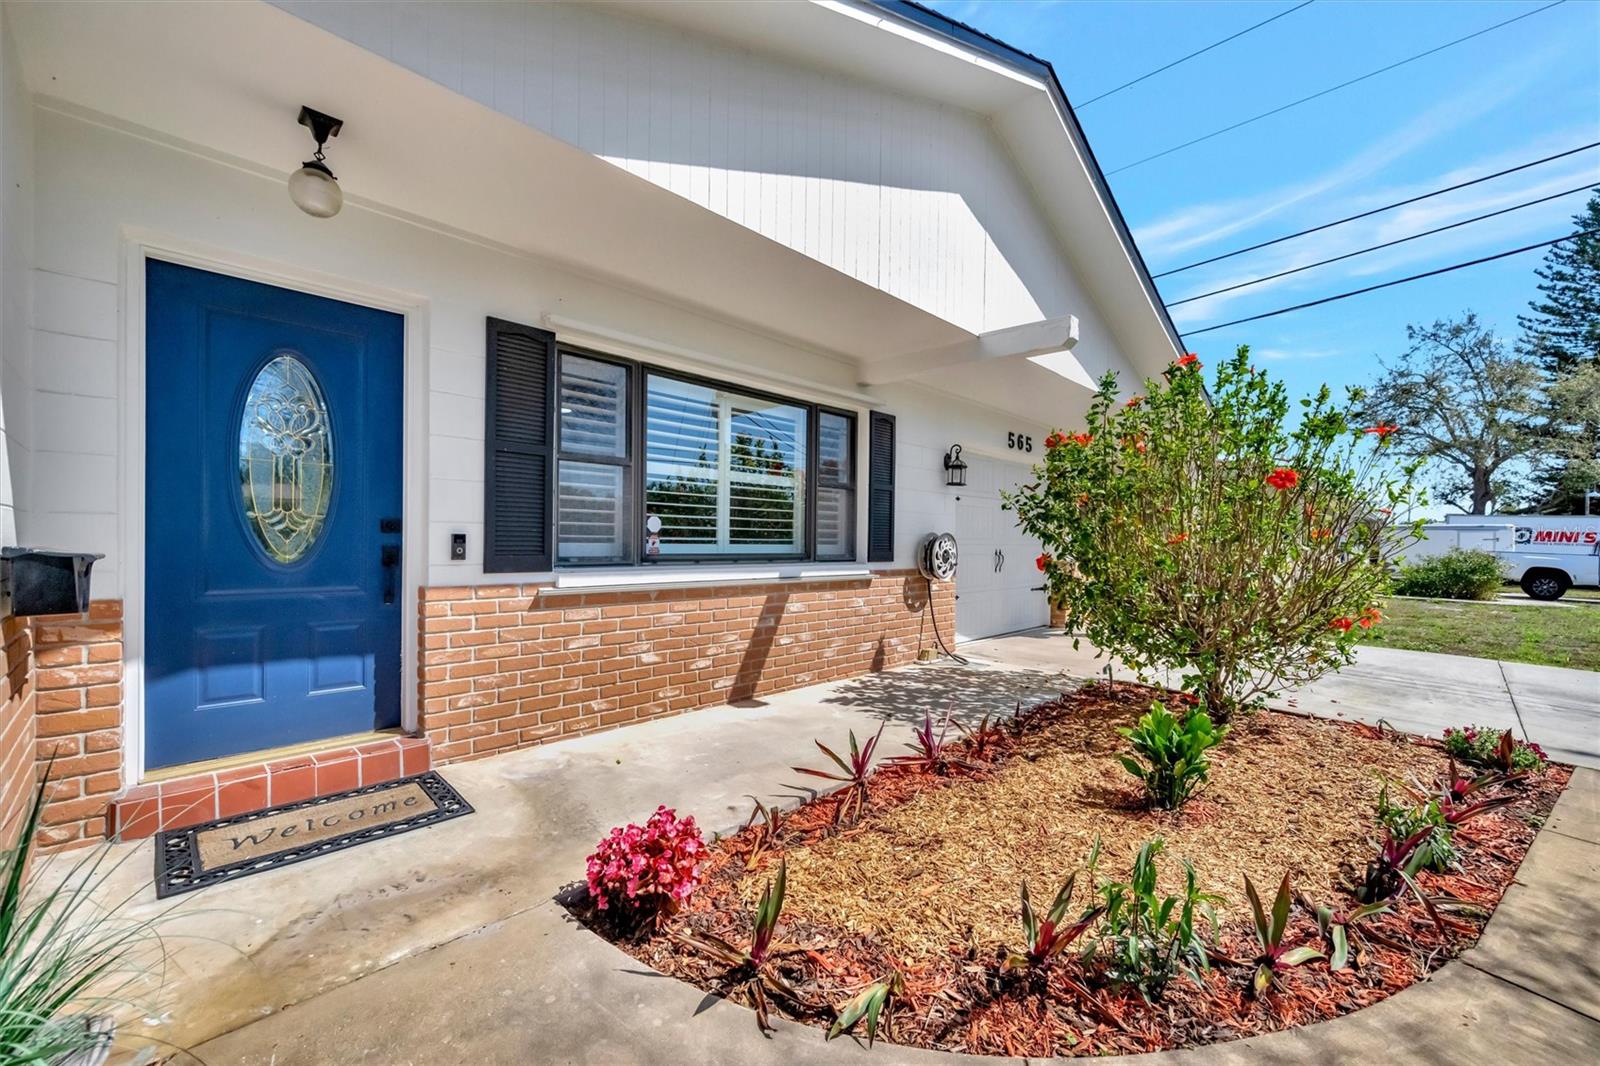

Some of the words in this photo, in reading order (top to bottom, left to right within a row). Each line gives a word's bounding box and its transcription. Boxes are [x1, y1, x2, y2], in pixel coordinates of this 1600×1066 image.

[1007, 431, 1033, 453] 565
[1533, 530, 1598, 545] MINI'S
[224, 794, 419, 851] Welcome
